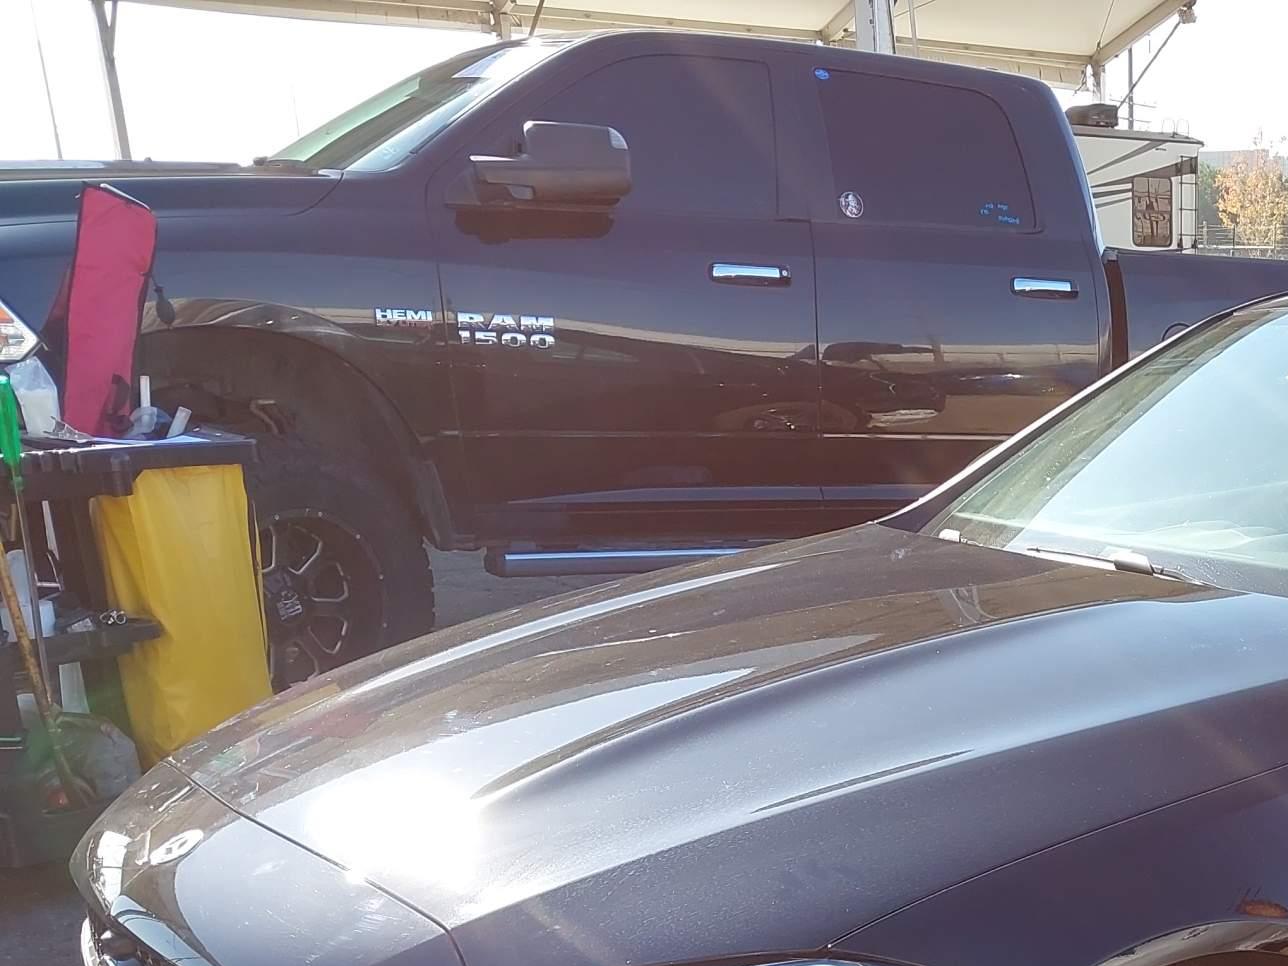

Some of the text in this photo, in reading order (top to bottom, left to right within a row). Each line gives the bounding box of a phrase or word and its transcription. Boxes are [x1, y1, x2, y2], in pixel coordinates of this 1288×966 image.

[375, 308, 432, 320] HEMI
[457, 312, 555, 330] RAM
[457, 330, 556, 349] 1500
